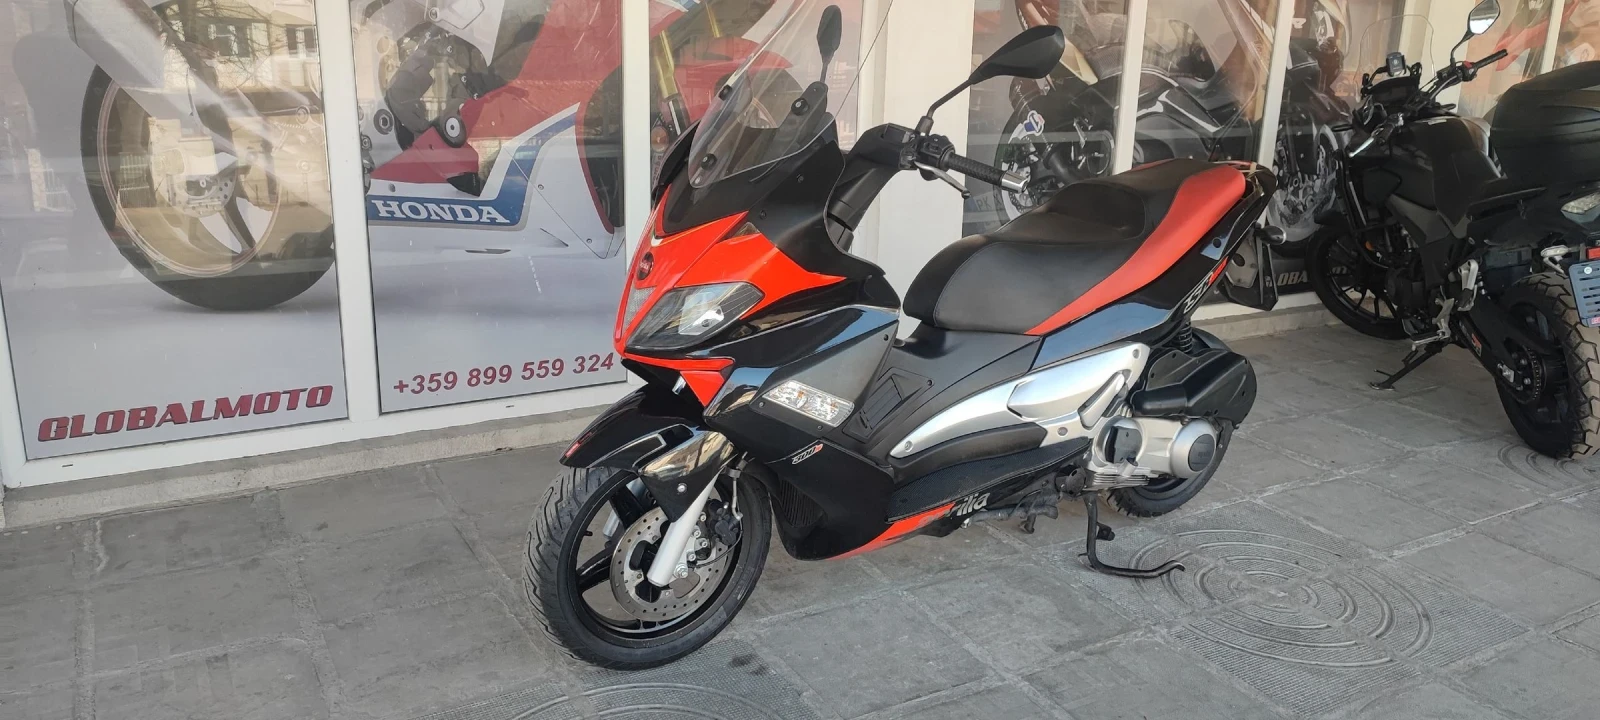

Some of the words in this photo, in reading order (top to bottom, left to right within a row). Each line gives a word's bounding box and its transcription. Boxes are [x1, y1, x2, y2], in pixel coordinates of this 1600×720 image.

[371, 199, 511, 224] HONDA
[393, 371, 458, 395] +359
[467, 364, 513, 388] 899
[520, 358, 565, 381] 559
[572, 352, 614, 374] 324
[37, 385, 334, 442] GLOBALMOTO
